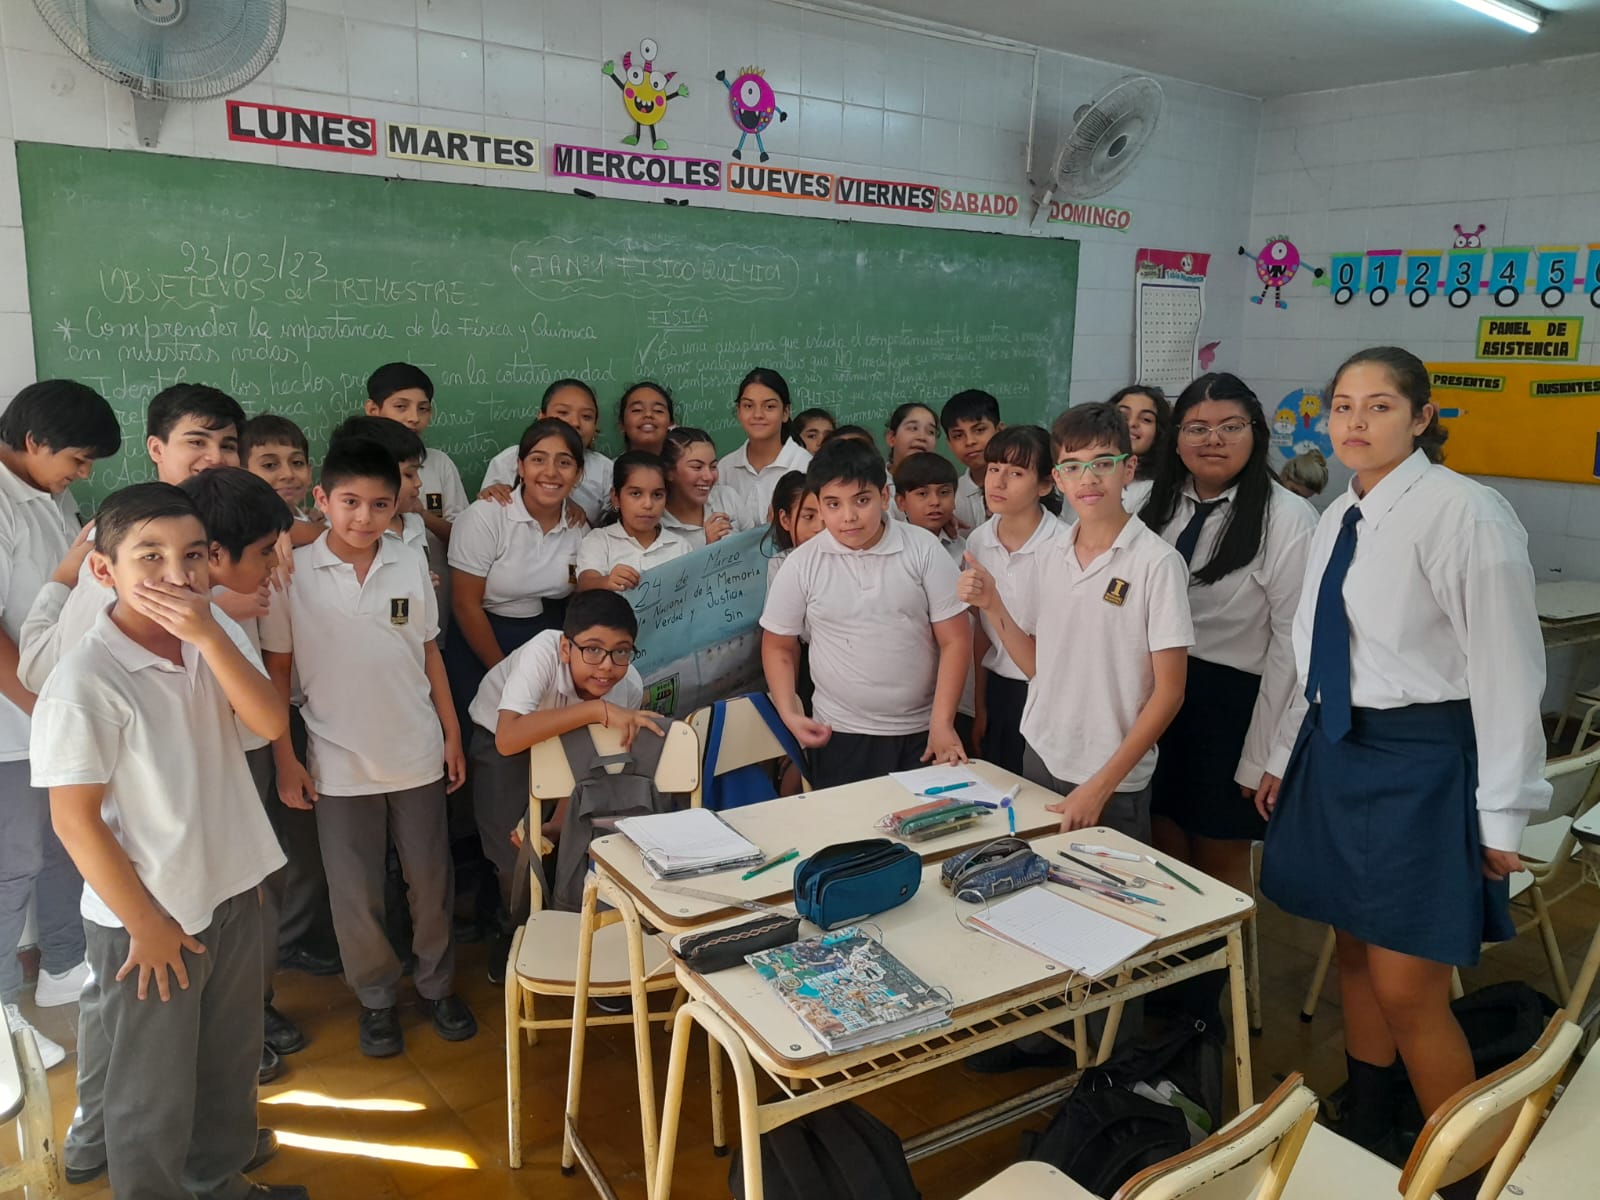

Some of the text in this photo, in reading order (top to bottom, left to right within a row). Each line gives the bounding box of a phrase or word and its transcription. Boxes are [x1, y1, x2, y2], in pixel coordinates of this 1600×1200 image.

[230, 104, 372, 149] LUNES
[389, 124, 534, 167] MARTES
[555, 147, 720, 187] MIERCOLES
[731, 166, 830, 198] JUEVES
[840, 181, 936, 209] VIERNES
[940, 189, 1019, 216] SABADO
[1049, 200, 1131, 229] DOMINGO
[180, 235, 328, 282] 23/03/23
[1339, 259, 1565, 286] 0 1 2 3 4 5
[86, 304, 238, 350] Comprender
[249, 305, 272, 340] la
[281, 311, 395, 352] importancia
[1489, 321, 1567, 336] PANEL DE
[1482, 341, 1569, 357] ASISTENCIA
[1432, 374, 1500, 389] PRESENTES
[1536, 381, 1600, 395] AUSENTES
[635, 577, 662, 609] 24
[724, 608, 744, 623] Sin
